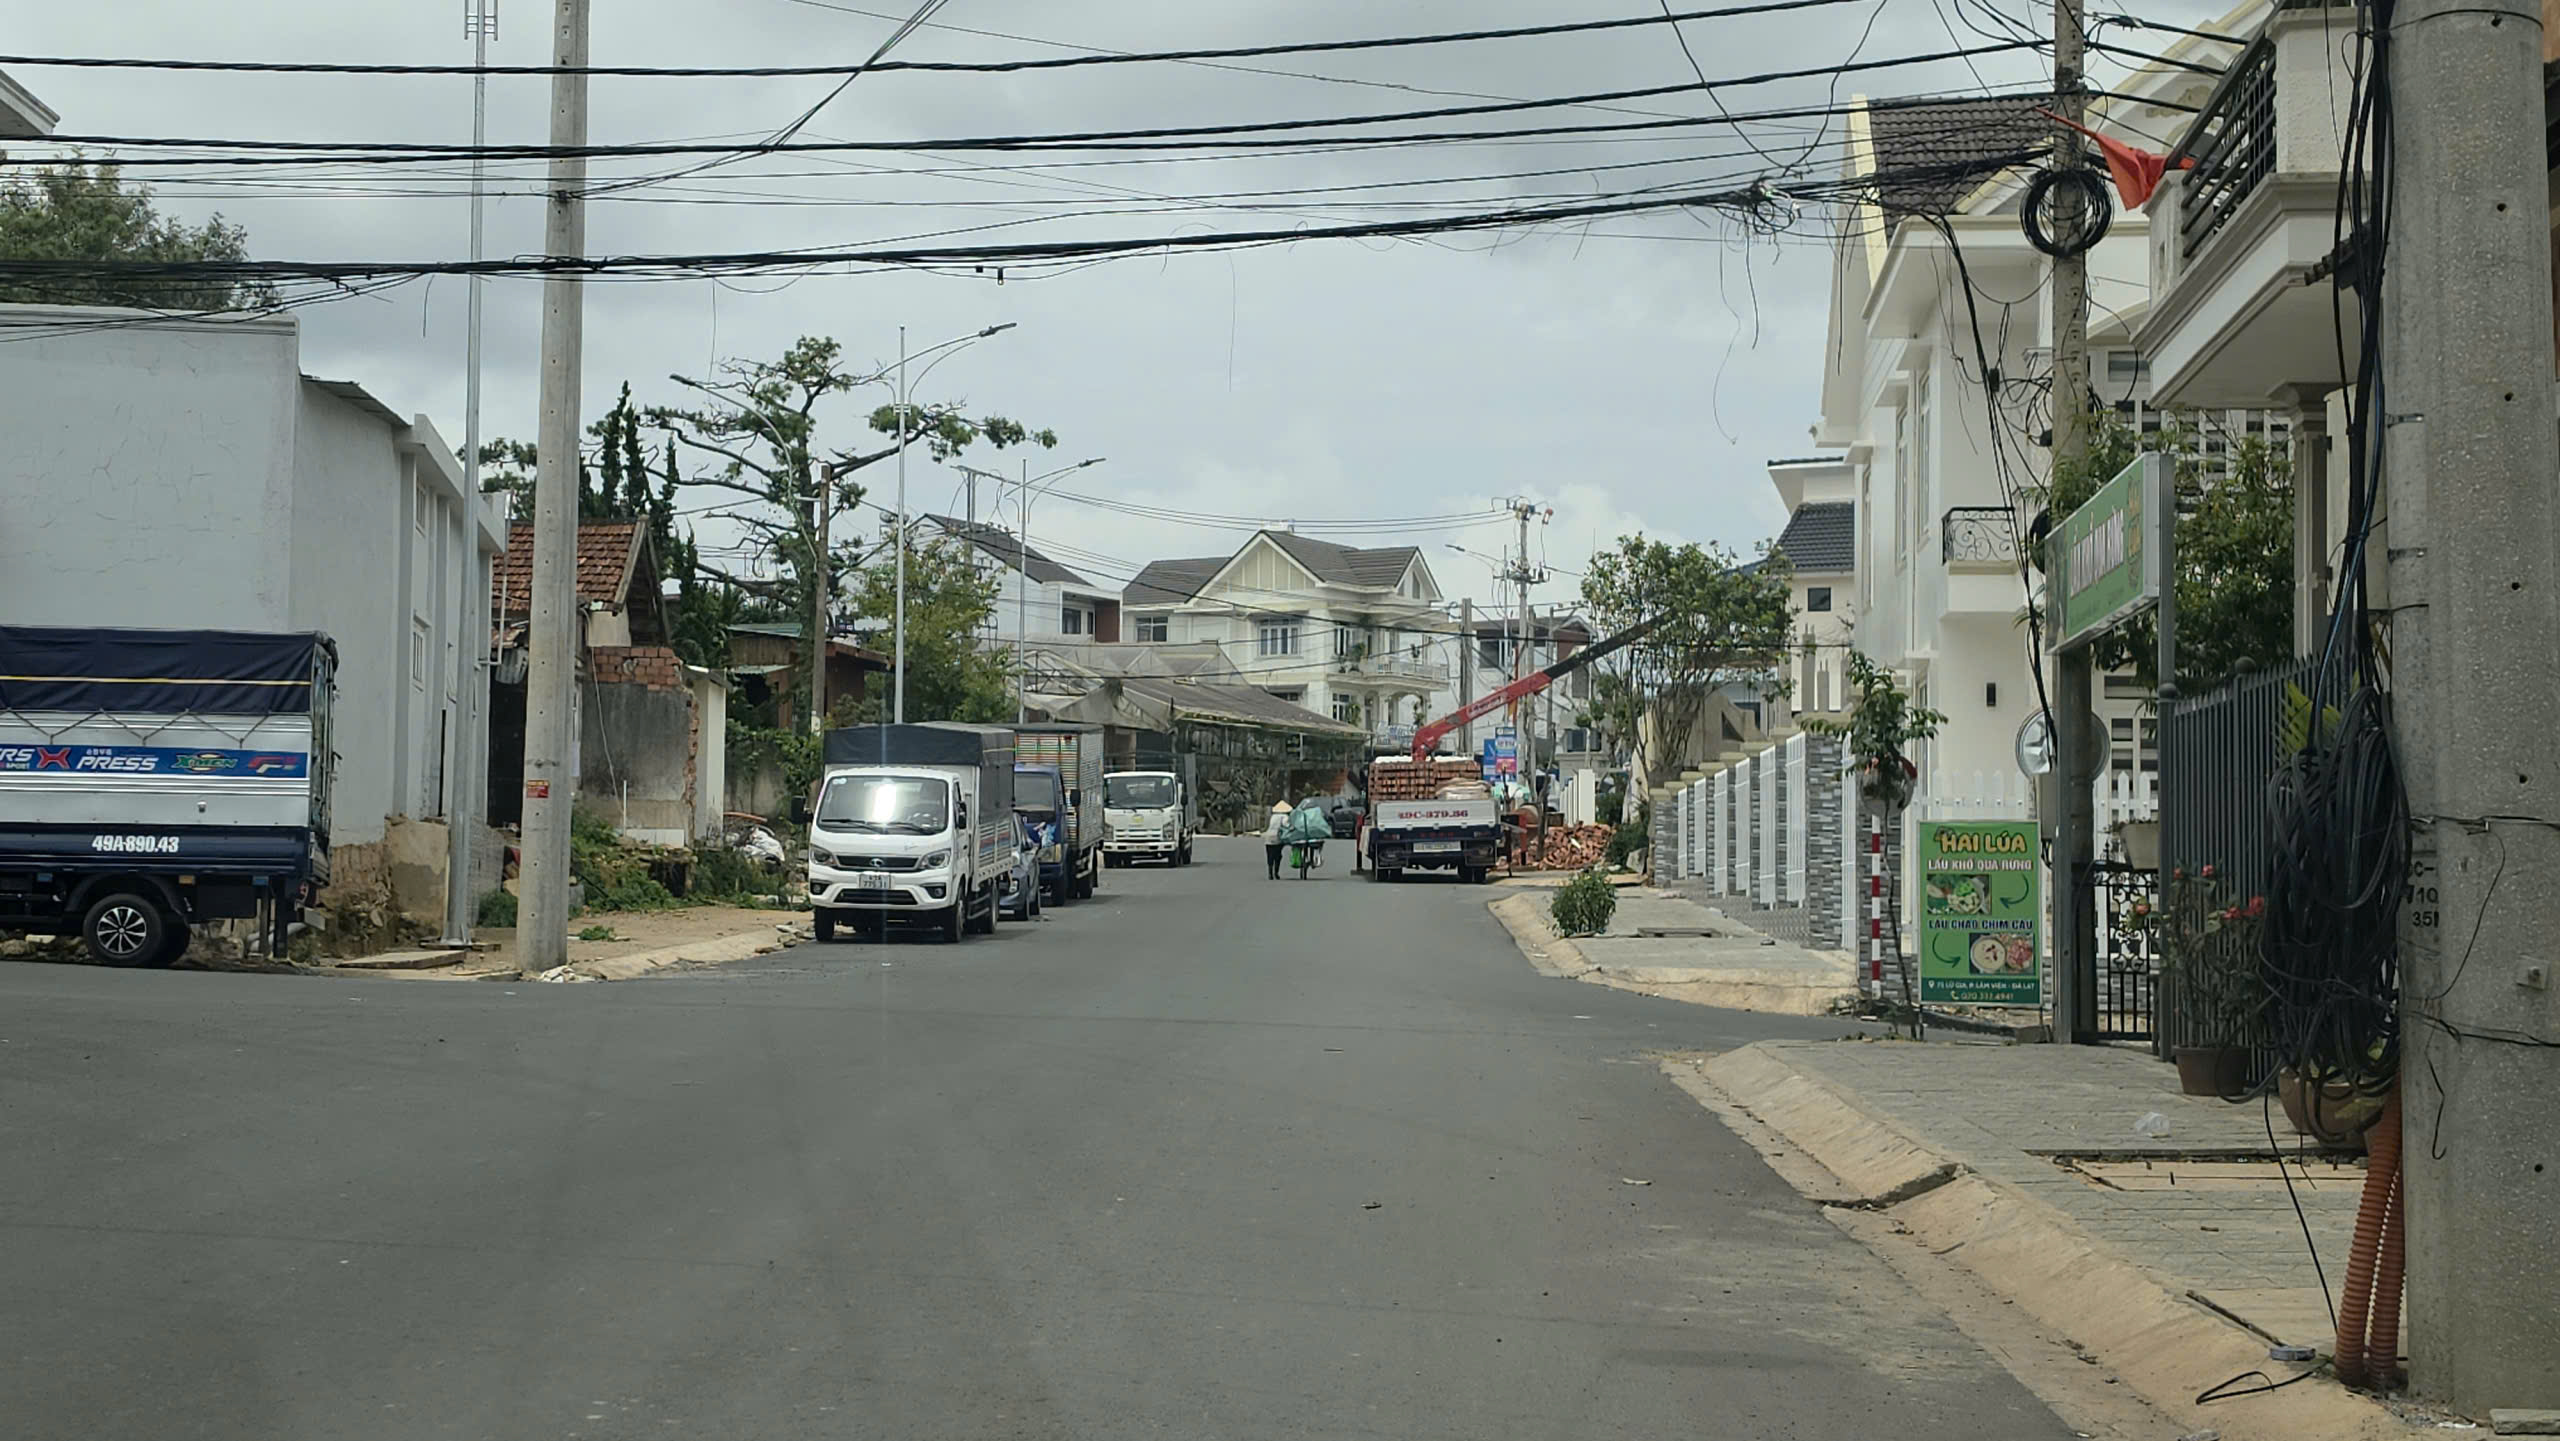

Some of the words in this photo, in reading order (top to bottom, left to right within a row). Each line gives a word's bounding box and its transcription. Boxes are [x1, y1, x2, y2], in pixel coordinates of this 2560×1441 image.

[76, 756, 158, 771] PRESS
[92, 835, 180, 853] 49A-890.43
[1941, 833, 1979, 853] HAI
[1984, 831, 2027, 853] LÚA
[1981, 919, 2009, 930] CHIM
